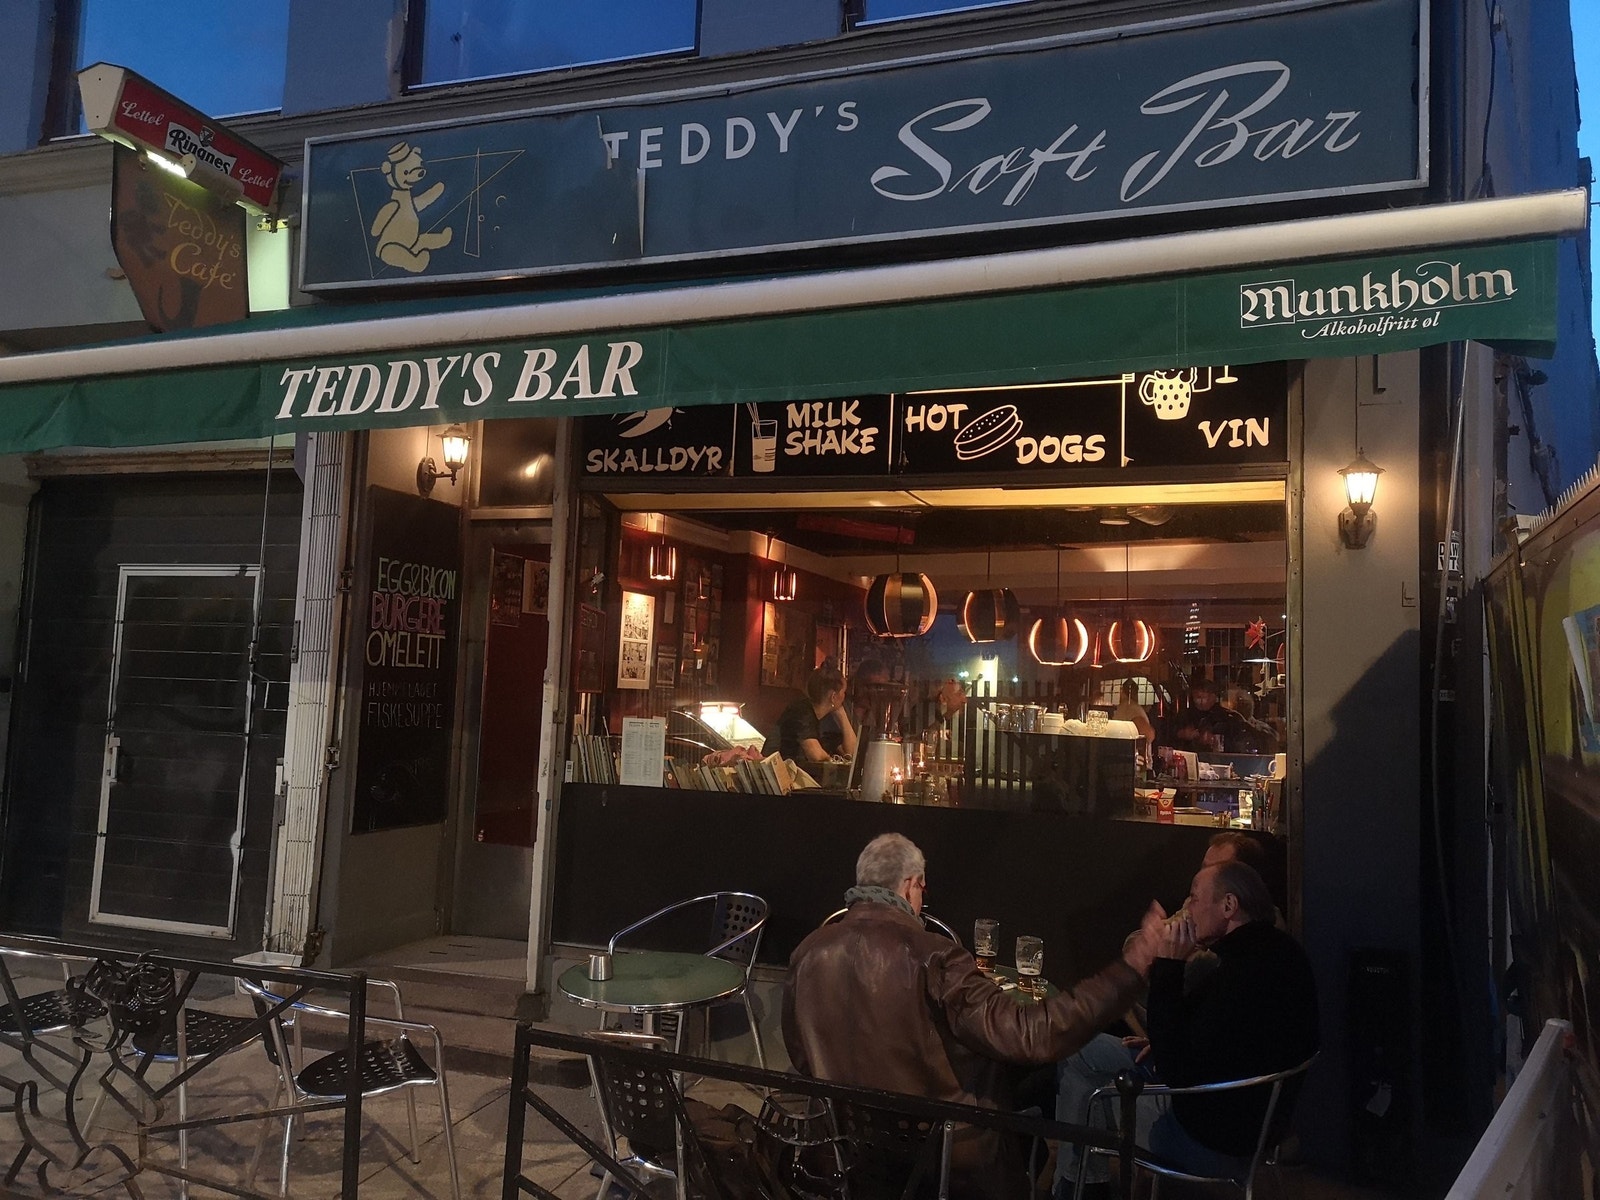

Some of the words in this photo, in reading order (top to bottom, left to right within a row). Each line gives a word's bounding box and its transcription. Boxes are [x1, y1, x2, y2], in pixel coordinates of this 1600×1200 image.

[168, 128, 232, 175] Ringnes
[602, 101, 859, 169] TEDDY'S
[870, 98, 1106, 205] Soft
[1120, 61, 1361, 202] Bar
[163, 192, 241, 261] Teddy's
[1241, 261, 1518, 321] Munkholm
[1301, 315, 1420, 339] Alkoholfritt
[1422, 311, 1440, 329] øl
[275, 351, 500, 420] TEDDY'S
[508, 341, 644, 403] BAR
[786, 399, 861, 429] MILK
[905, 403, 969, 432] HOT
[1197, 416, 1270, 449] VIN
[586, 445, 722, 473] SKALLDYR
[784, 428, 879, 457] SHAKE
[1015, 434, 1106, 464] DOGS
[371, 591, 447, 635] BURGERE
[366, 629, 446, 670] OMELETT
[367, 702, 443, 729] FISKESUPPE
